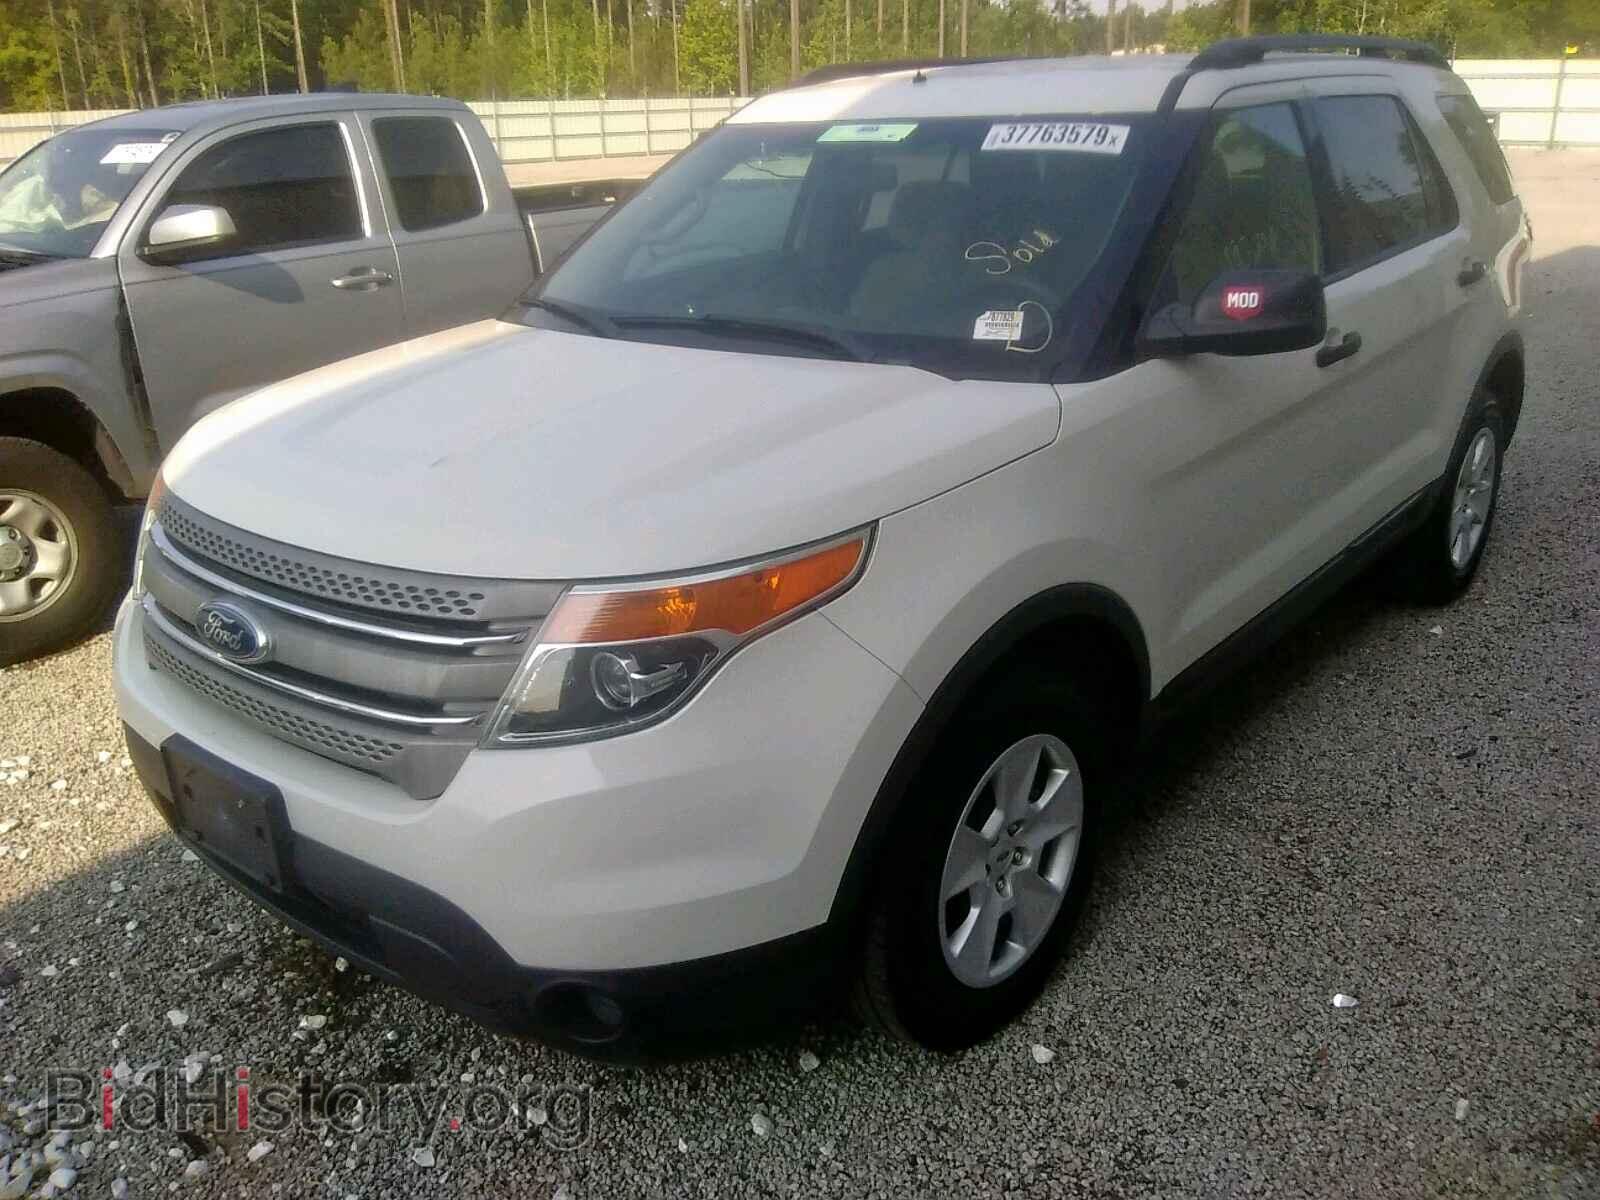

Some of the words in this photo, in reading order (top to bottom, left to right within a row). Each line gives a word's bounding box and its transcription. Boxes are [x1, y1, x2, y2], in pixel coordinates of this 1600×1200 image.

[1001, 125, 1110, 145] 37763579
[964, 229, 1059, 275] Sold
[1226, 291, 1260, 309] MOD
[203, 609, 245, 651] Ford
